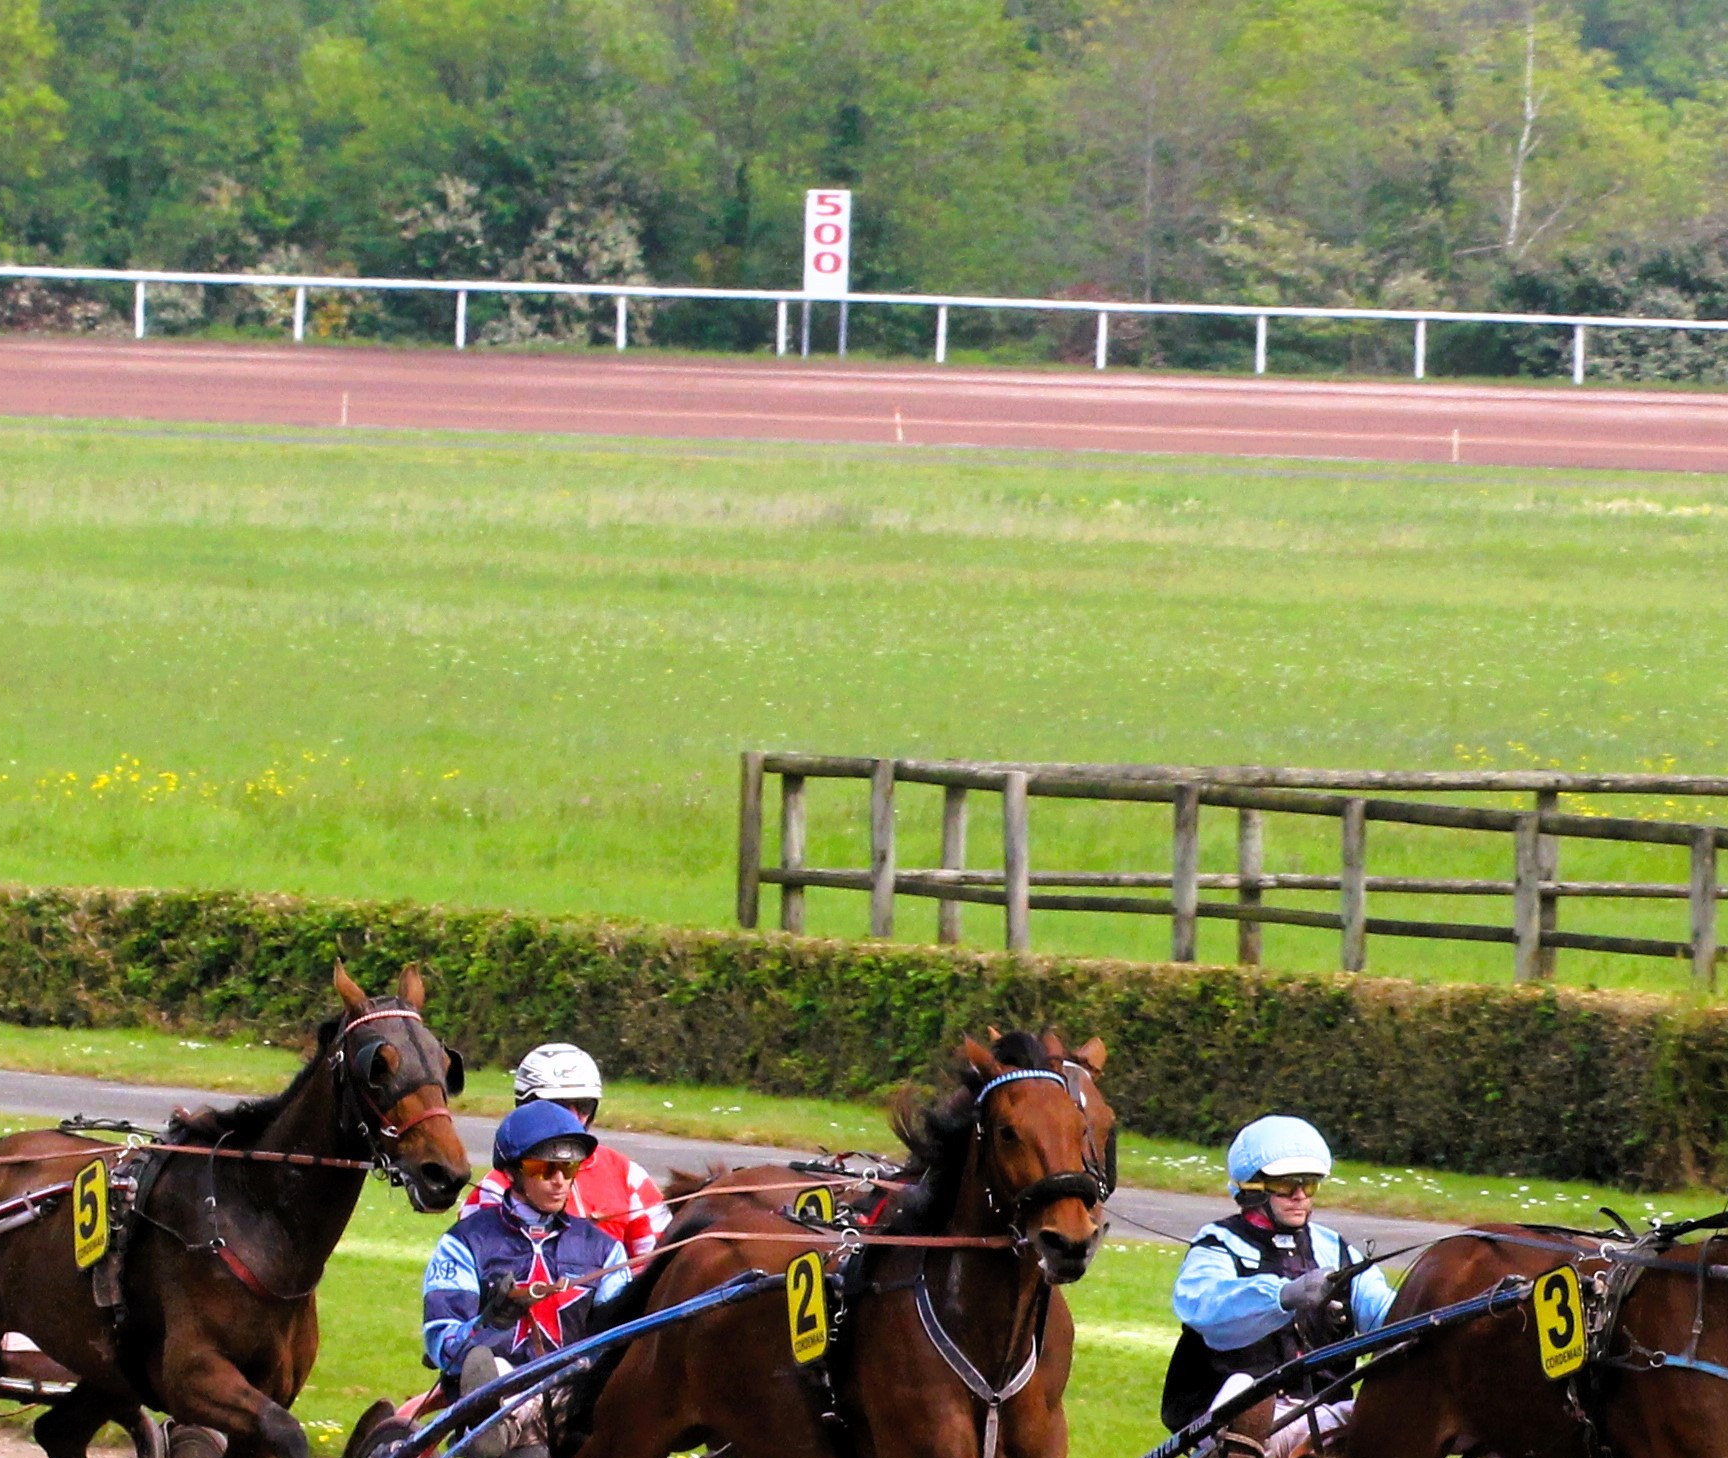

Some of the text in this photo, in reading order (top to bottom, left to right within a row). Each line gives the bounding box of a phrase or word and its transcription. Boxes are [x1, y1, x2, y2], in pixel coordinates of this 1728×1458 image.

[813, 194, 843, 274] 500
[79, 1165, 98, 1240] 5
[794, 1259, 817, 1335] 2
[1544, 1274, 1575, 1349] 3
